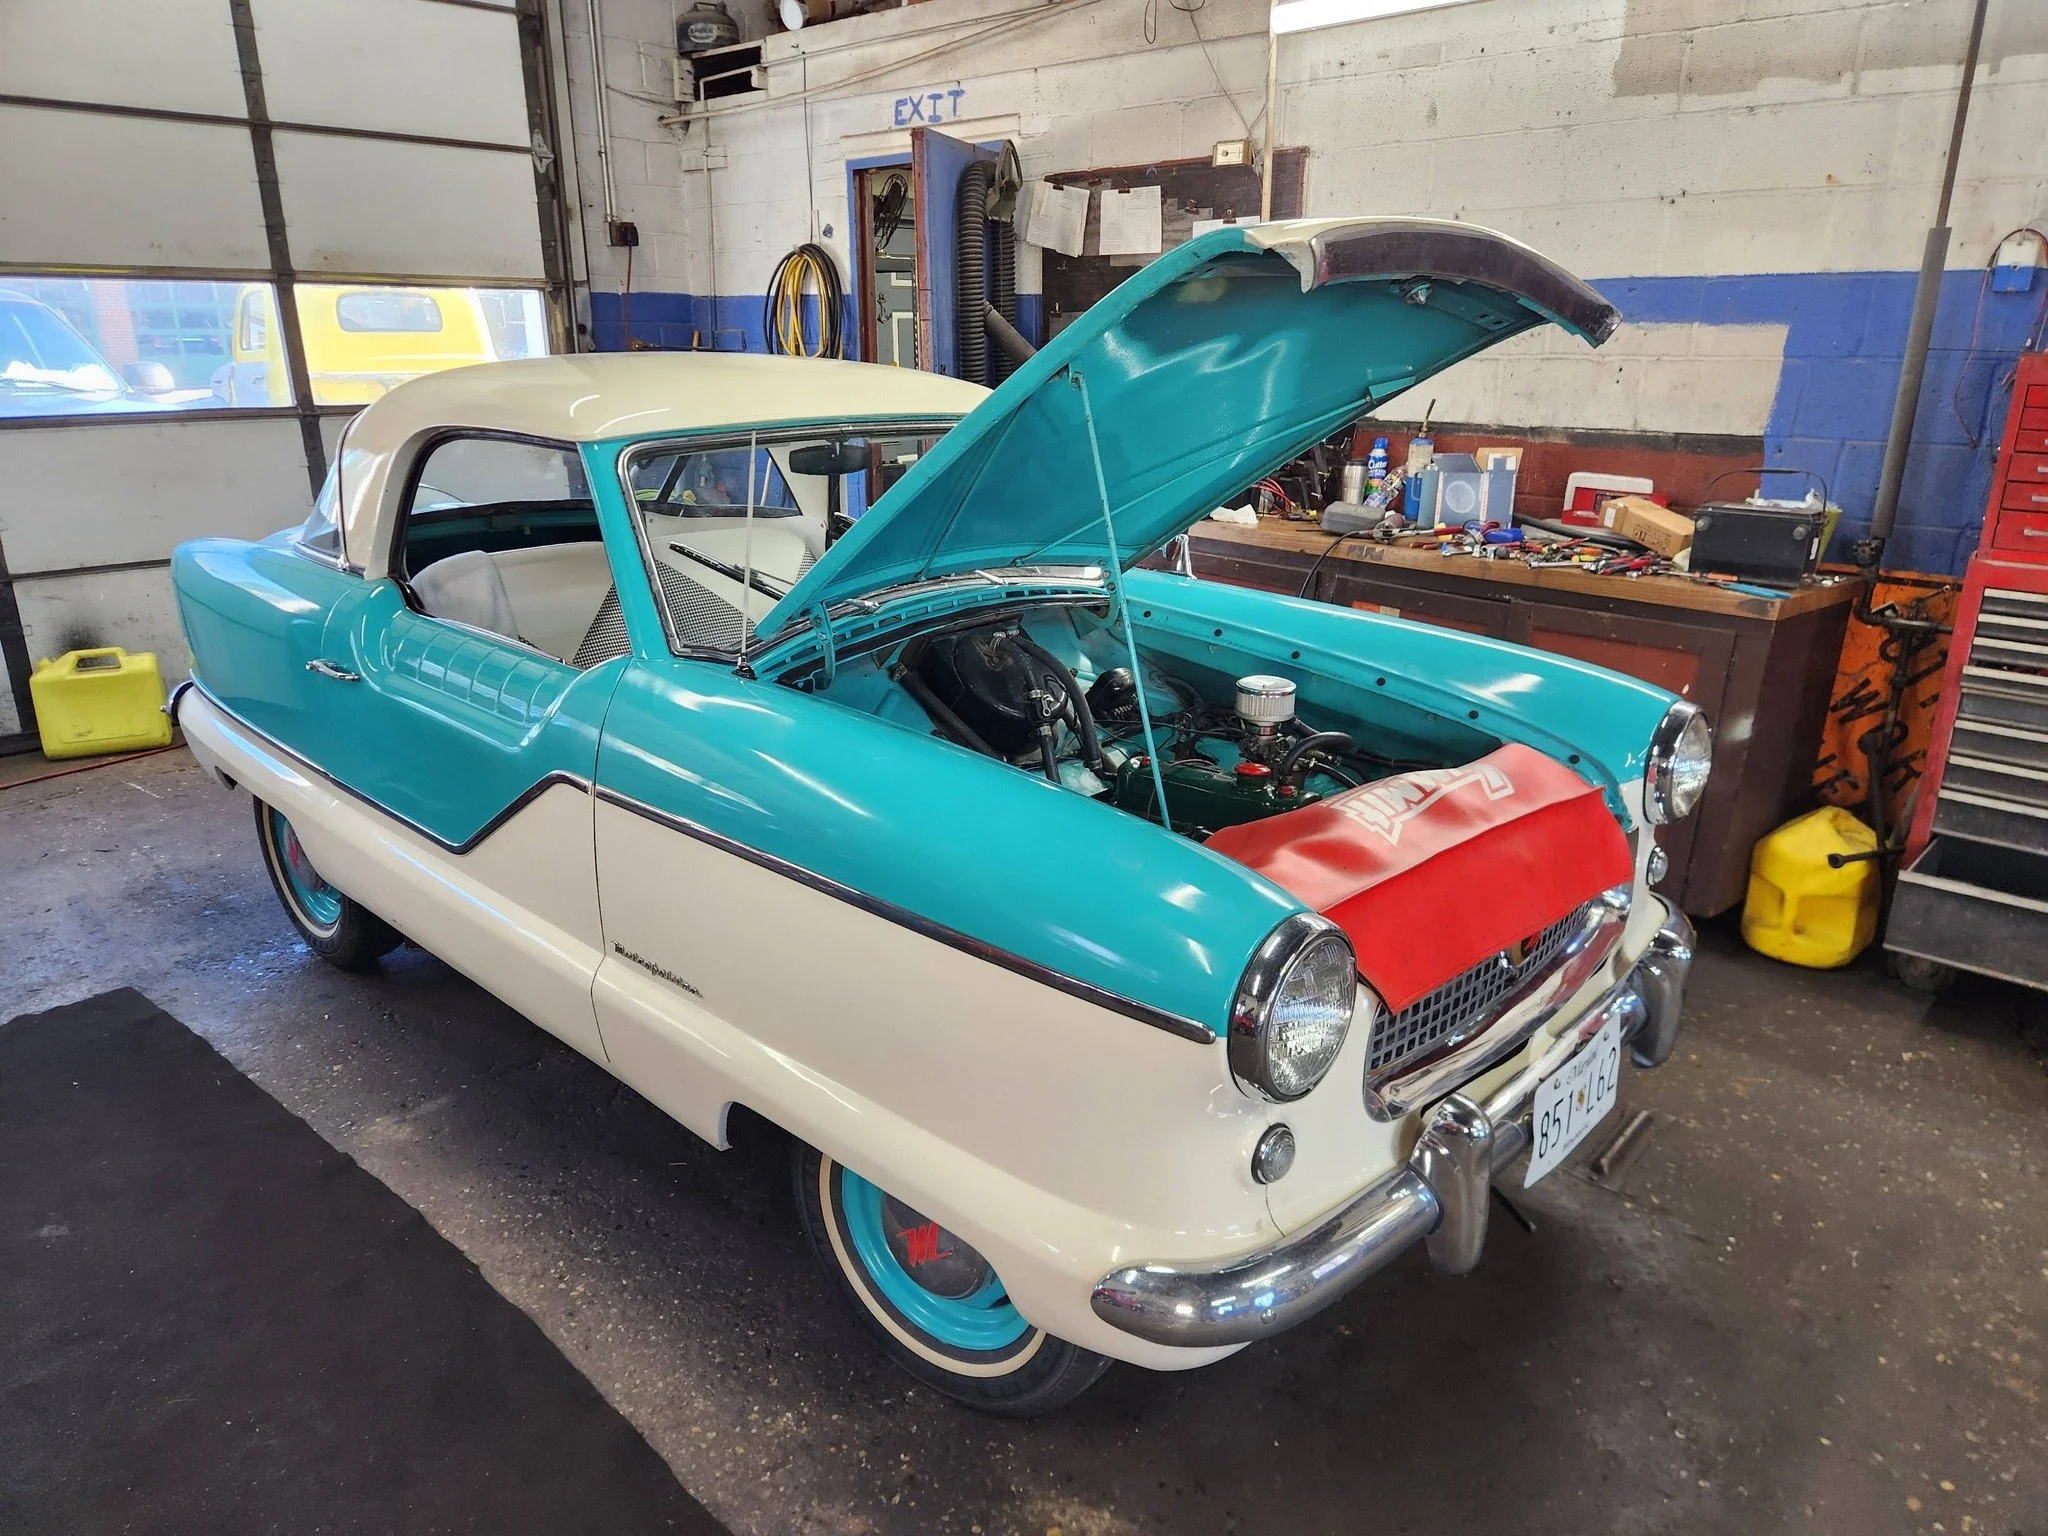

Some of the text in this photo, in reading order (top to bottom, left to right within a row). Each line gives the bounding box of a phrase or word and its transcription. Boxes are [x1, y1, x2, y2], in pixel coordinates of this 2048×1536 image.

[894, 89, 966, 126] EXIT
[1539, 1090, 1573, 1159] 851
[1586, 1046, 1616, 1115] L62
